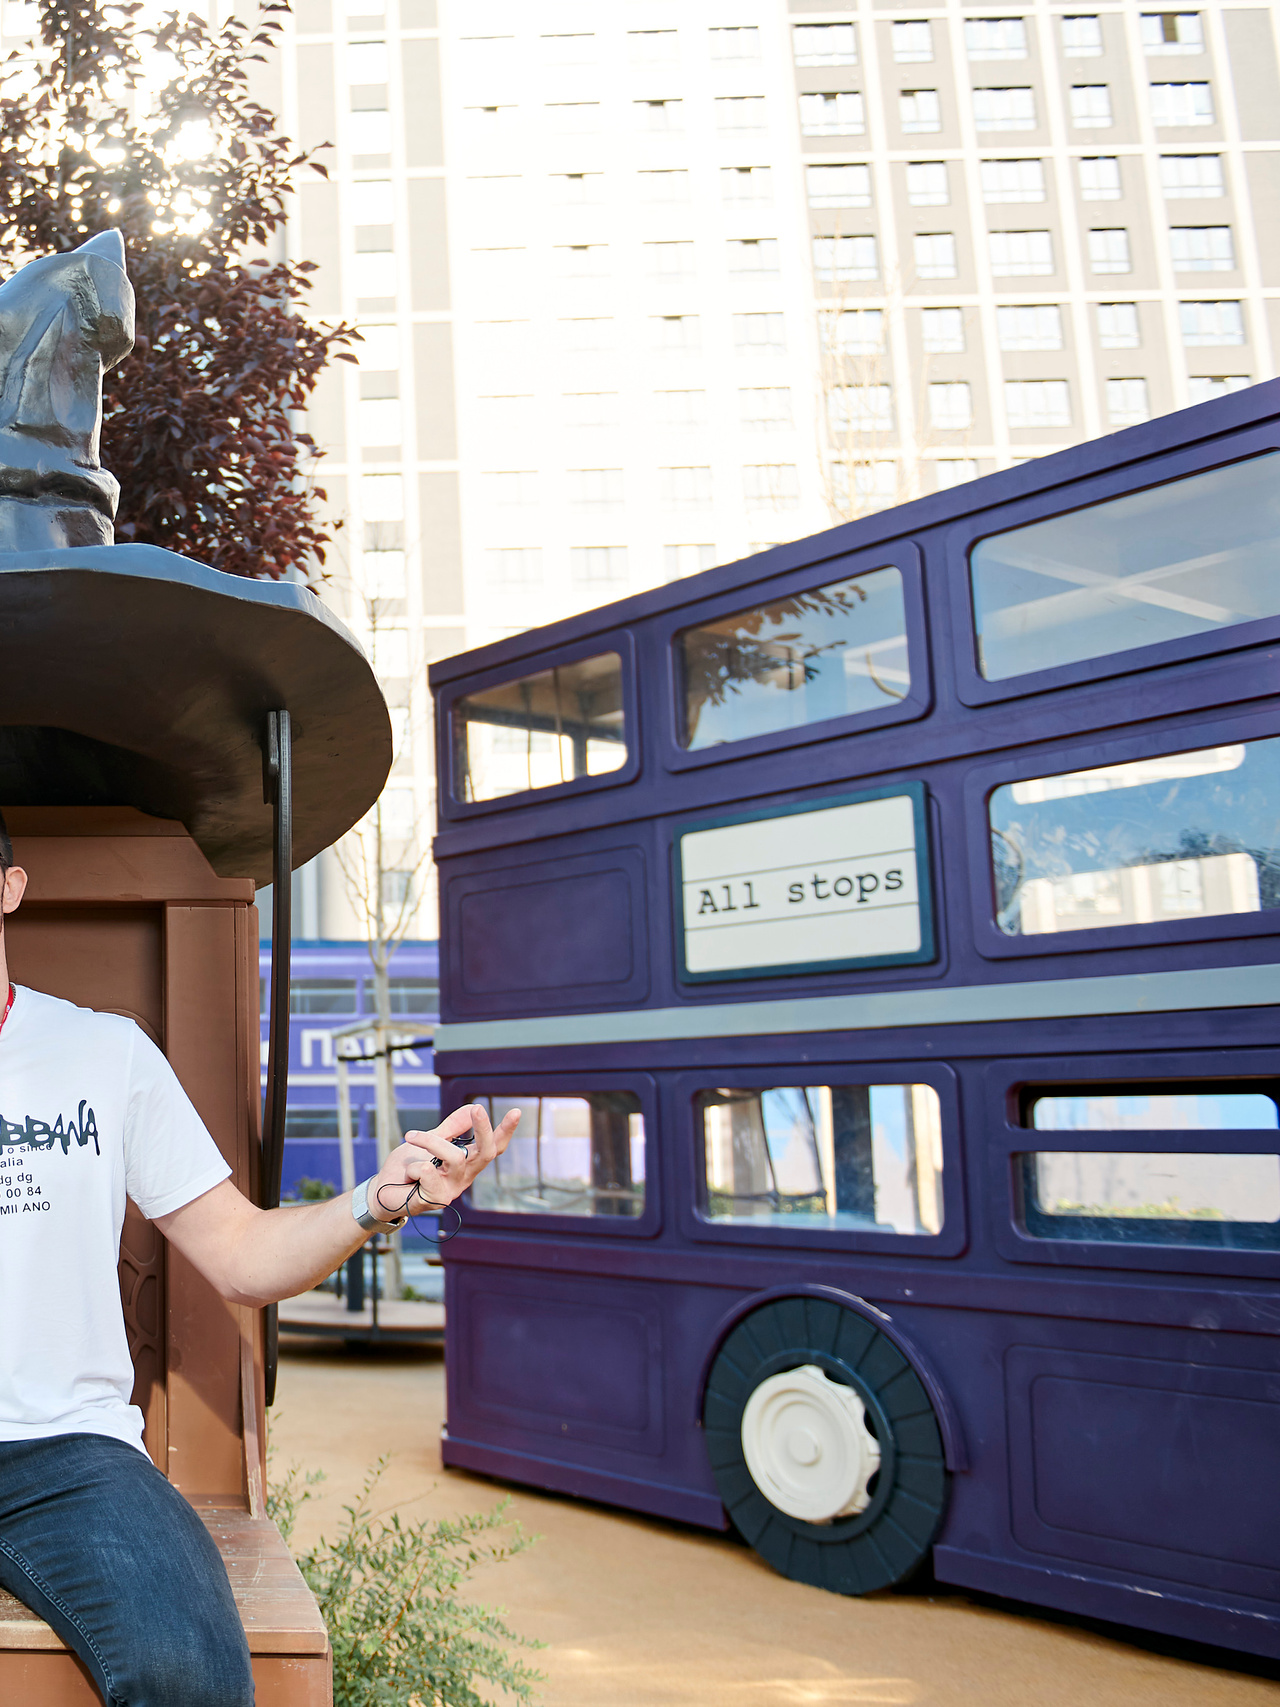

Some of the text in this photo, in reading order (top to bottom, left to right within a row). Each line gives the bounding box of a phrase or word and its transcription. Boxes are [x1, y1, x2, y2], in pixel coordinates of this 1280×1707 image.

[697, 868, 904, 915] All stops
[17, 1172, 33, 1184] dg
[6, 1187, 22, 1198] 00
[26, 1185, 42, 1196] 84
